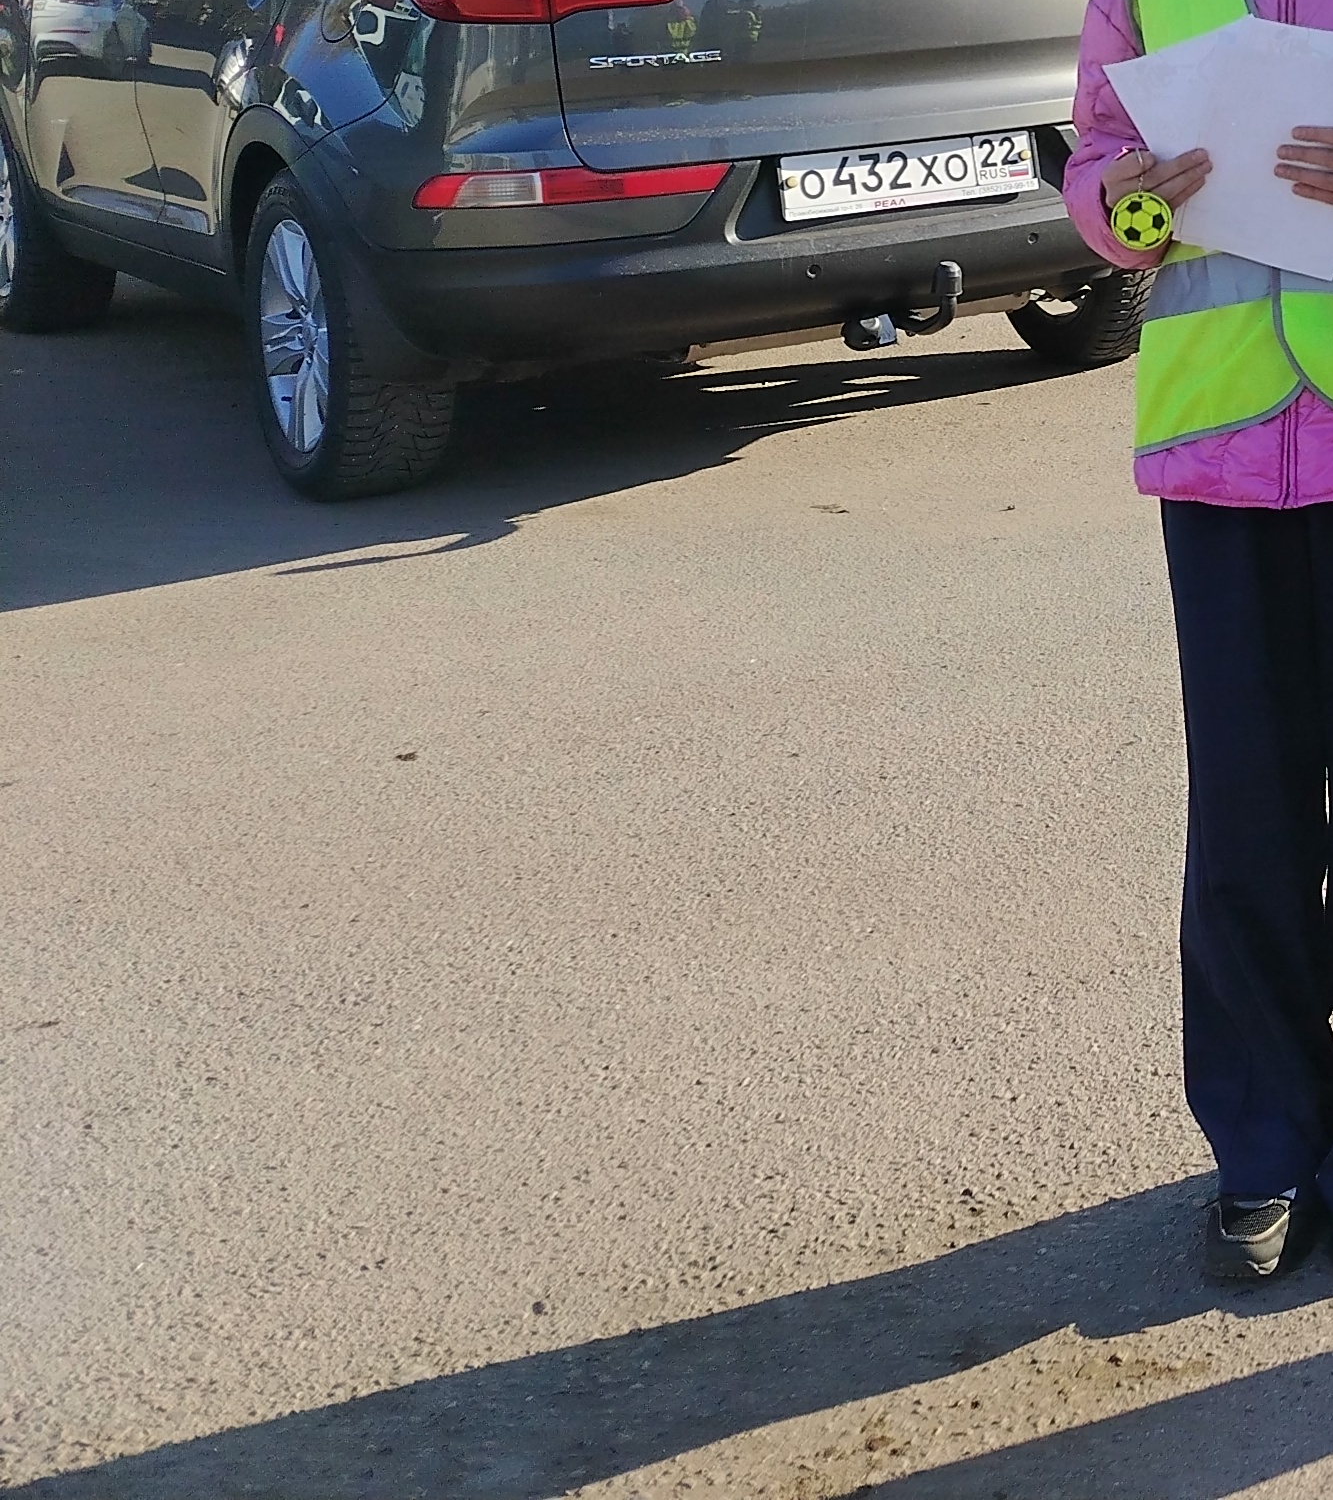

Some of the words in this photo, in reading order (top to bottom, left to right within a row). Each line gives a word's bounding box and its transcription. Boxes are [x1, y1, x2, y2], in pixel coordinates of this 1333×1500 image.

[589, 50, 722, 69] SPORTAGE
[978, 136, 1018, 168] 22
[979, 167, 1007, 180] RUS
[874, 198, 906, 208] РЕАЛ
